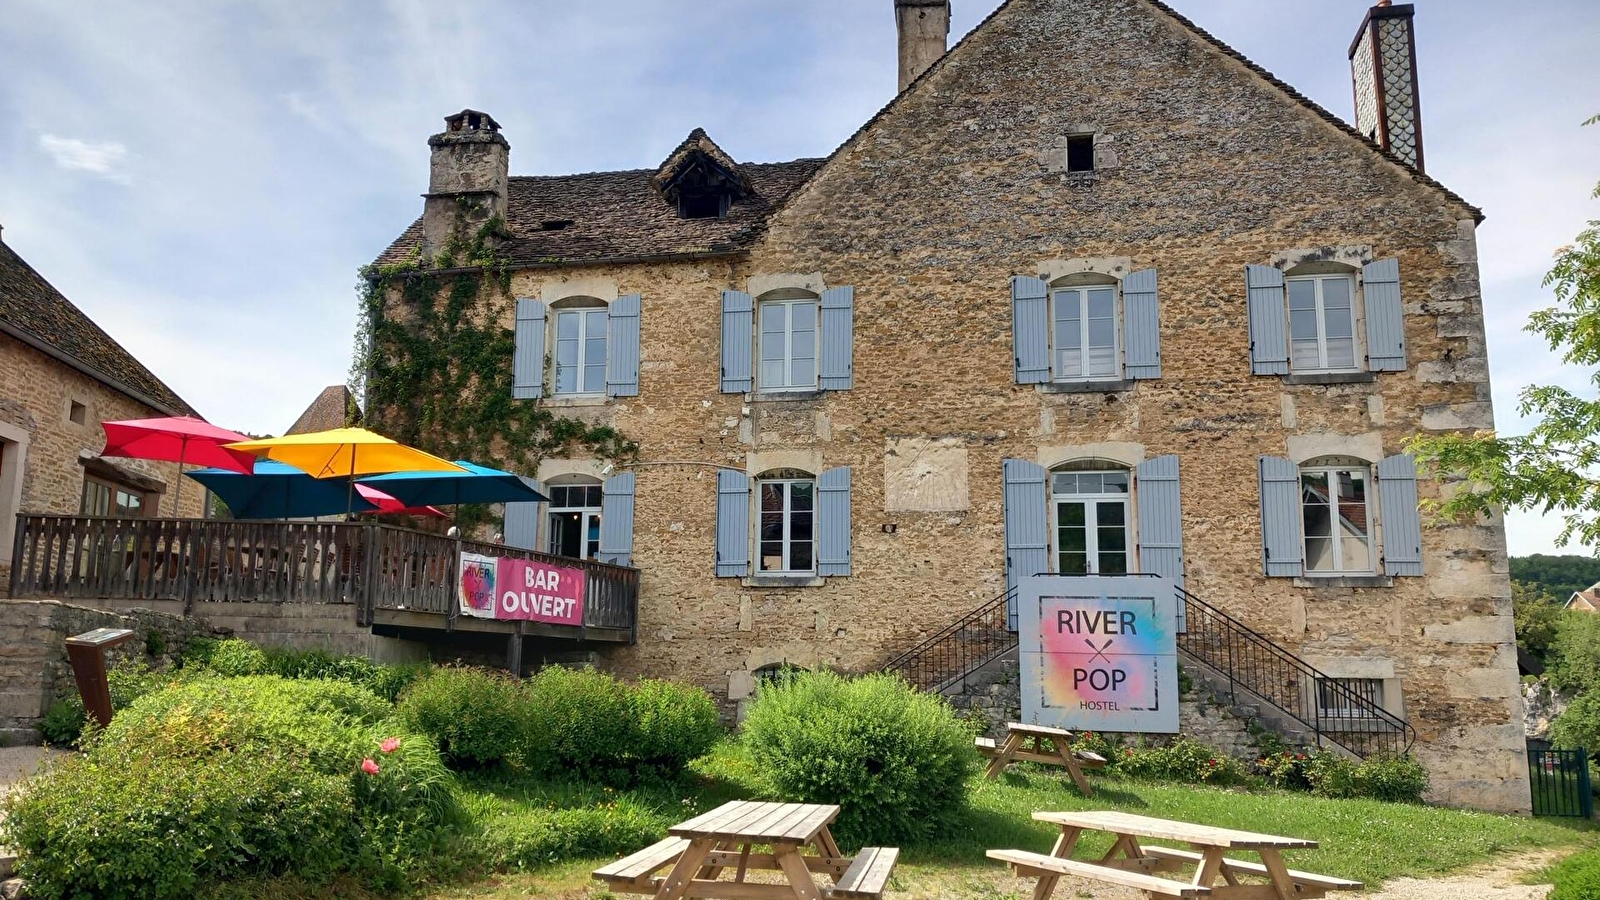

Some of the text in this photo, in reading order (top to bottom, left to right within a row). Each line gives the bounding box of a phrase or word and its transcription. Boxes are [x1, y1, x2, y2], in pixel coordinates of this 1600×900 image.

[466, 566, 490, 579] RIVER
[525, 566, 560, 592] BAR
[502, 590, 576, 619] OUVERT
[1057, 610, 1137, 635] RIVER
[1073, 668, 1127, 691] POP
[1080, 700, 1120, 711] HOSTEL
